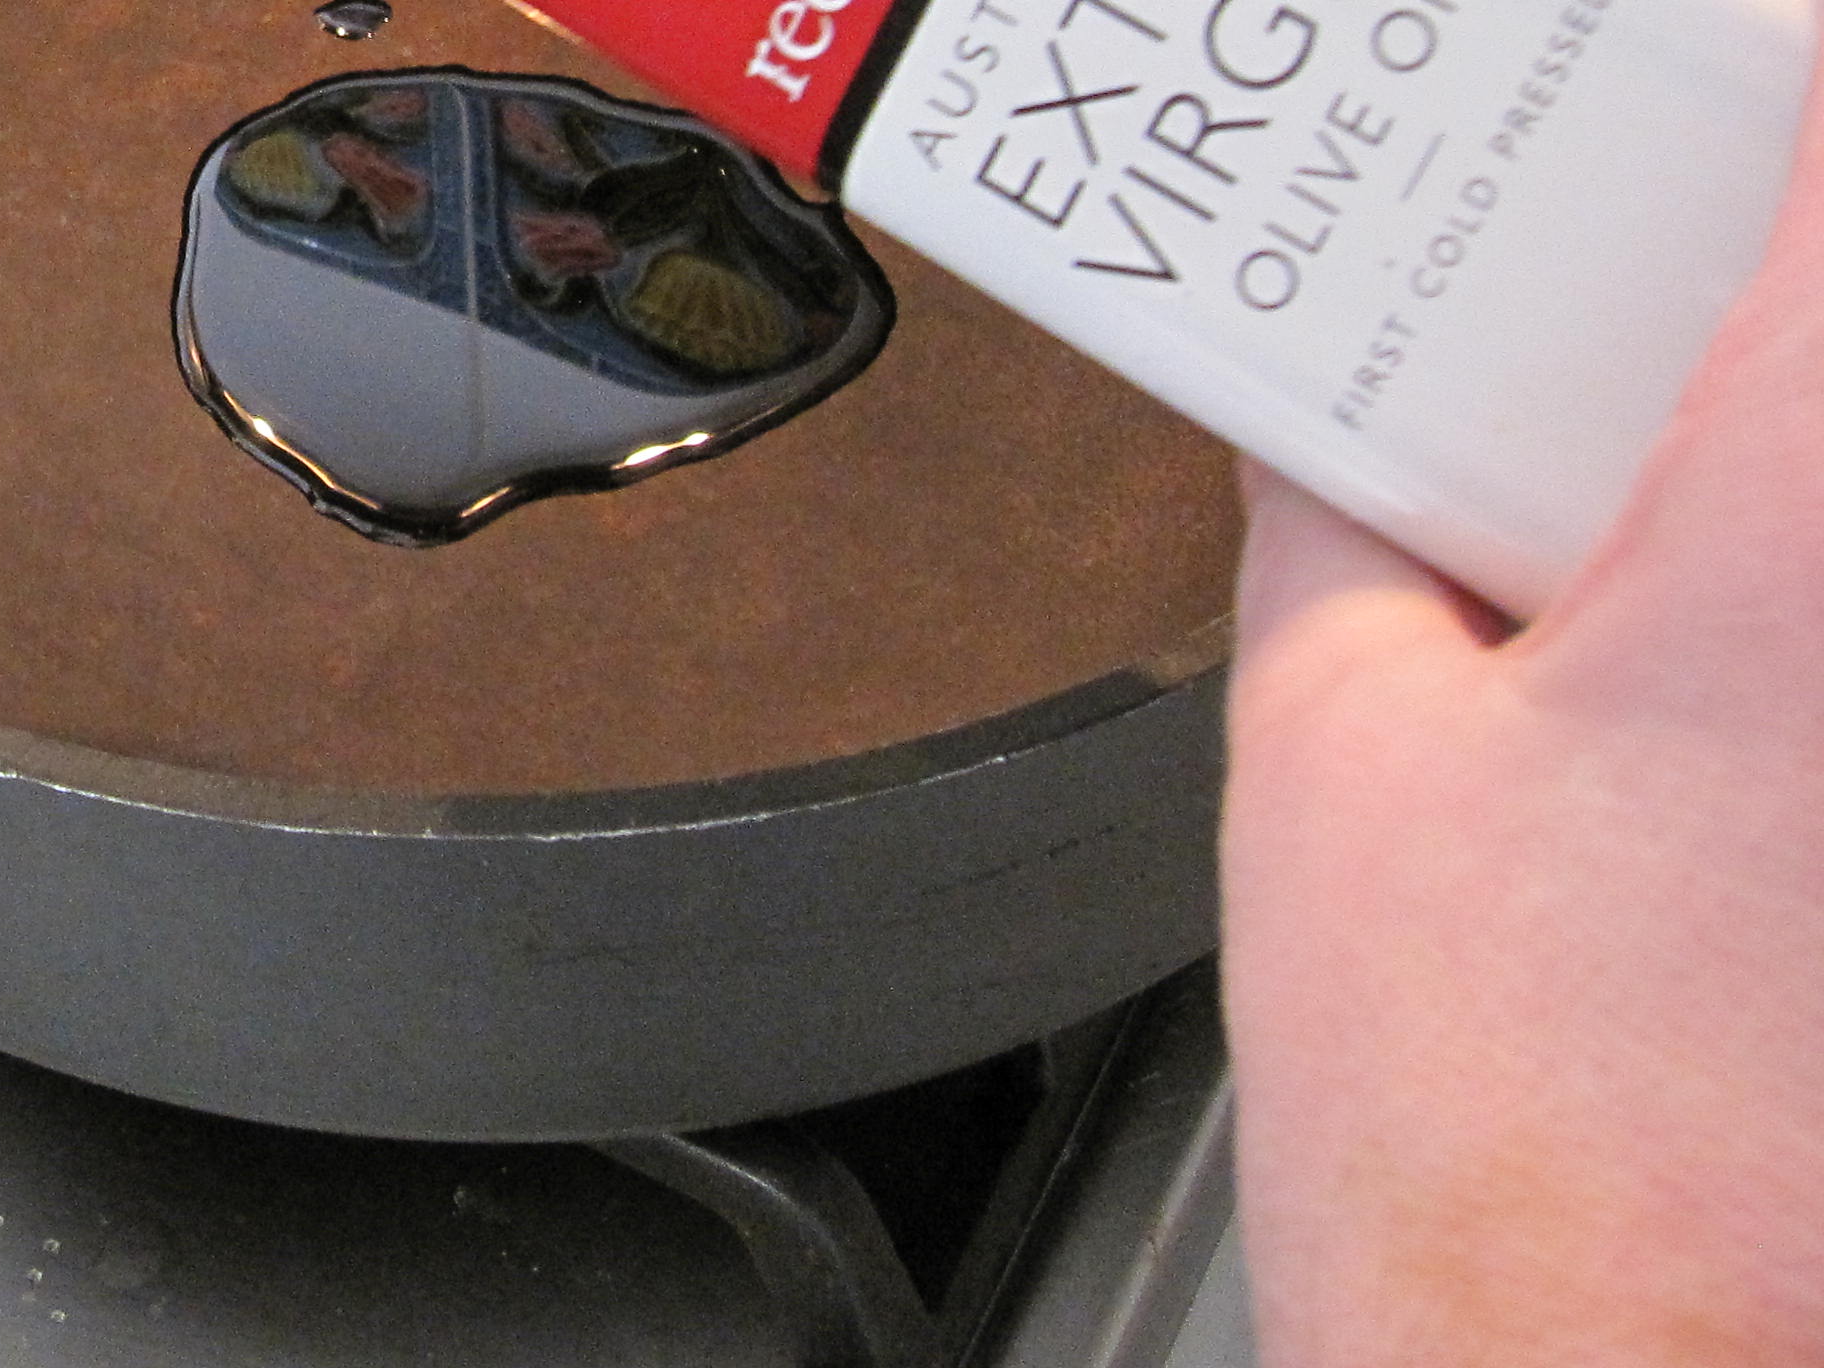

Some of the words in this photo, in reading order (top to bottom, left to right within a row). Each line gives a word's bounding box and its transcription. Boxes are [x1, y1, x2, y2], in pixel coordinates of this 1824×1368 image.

[1235, 91, 1396, 312] OLIVE
[1330, 312, 1418, 431] FIRST
[1410, 176, 1501, 299] COLD
